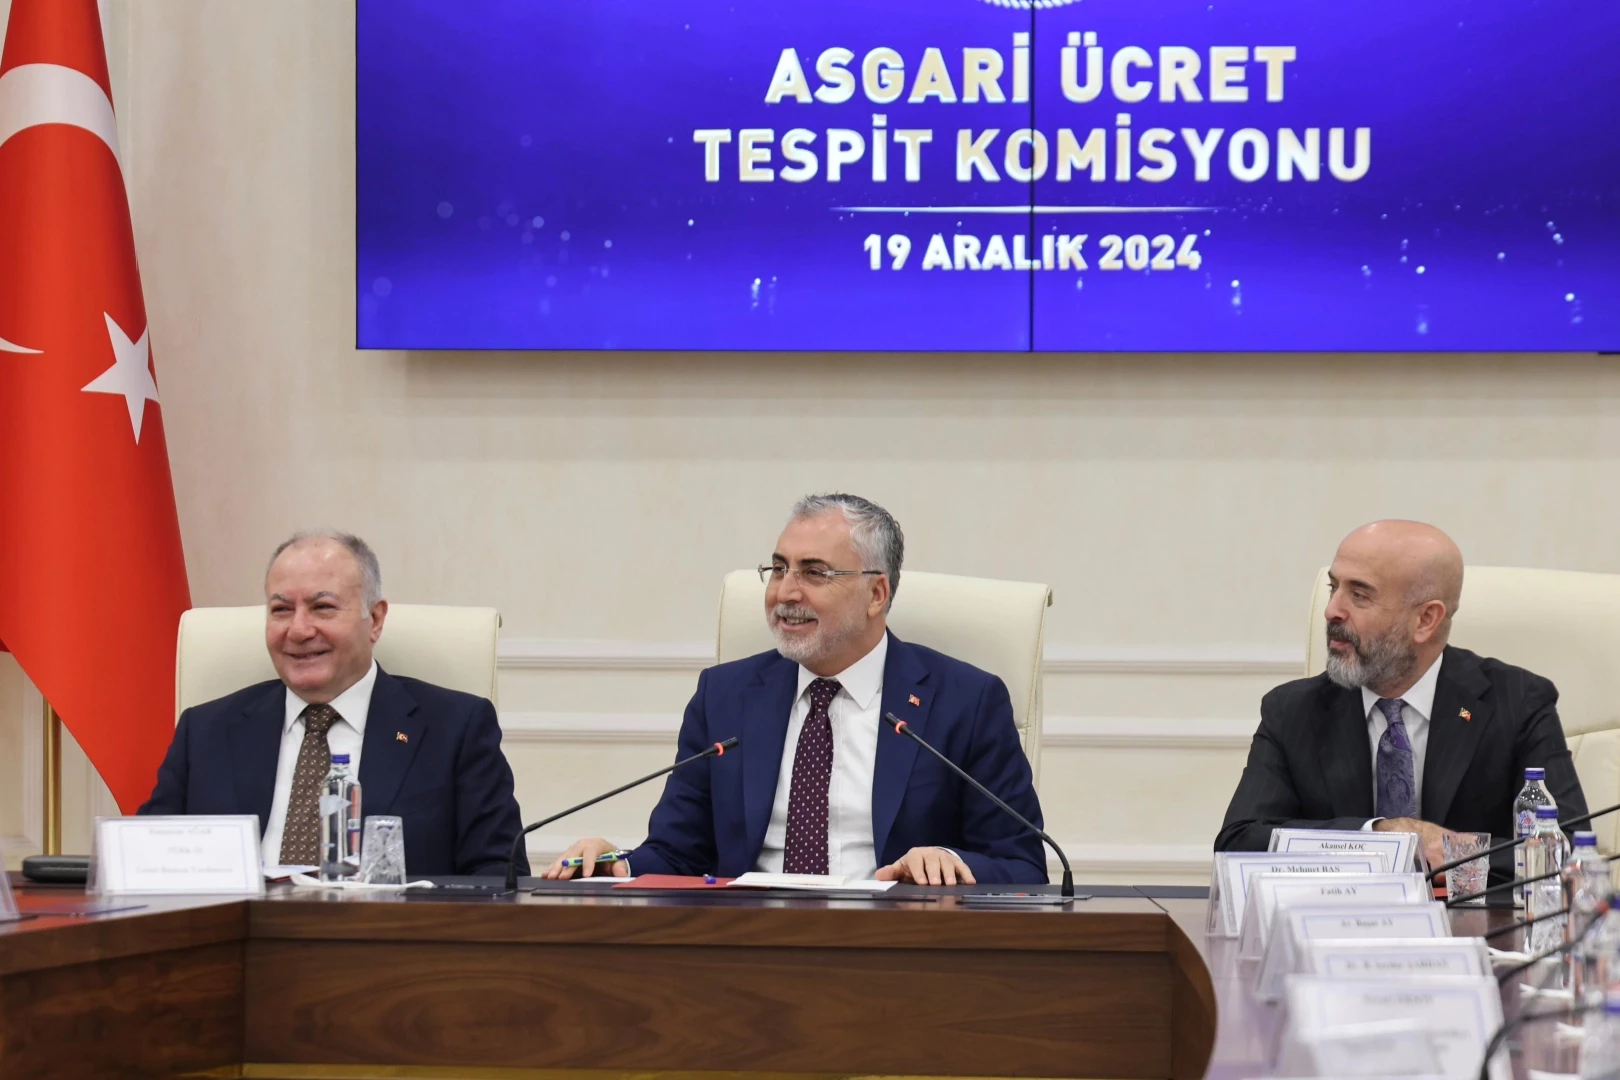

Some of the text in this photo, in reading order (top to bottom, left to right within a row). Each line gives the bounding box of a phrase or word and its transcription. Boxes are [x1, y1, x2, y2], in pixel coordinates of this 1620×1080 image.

[764, 31, 1297, 104] ASGARİ ÜCRET
[693, 113, 1371, 183] TESPİT KOMİSYONU
[863, 233, 1202, 271] 19 ARALIK 2024
[1318, 842, 1347, 850] Akansel
[1287, 865, 1320, 873] Mehmet
